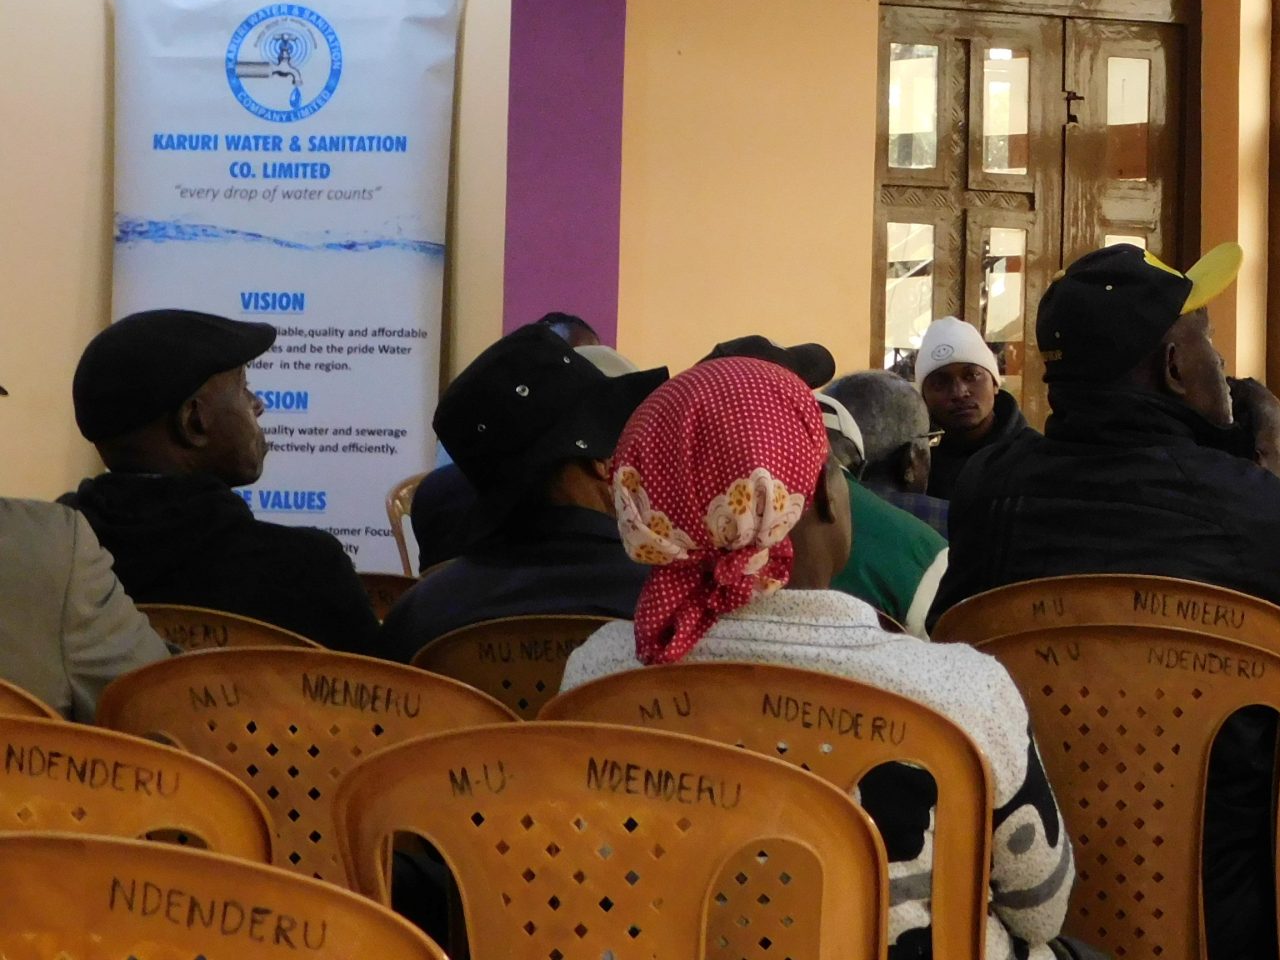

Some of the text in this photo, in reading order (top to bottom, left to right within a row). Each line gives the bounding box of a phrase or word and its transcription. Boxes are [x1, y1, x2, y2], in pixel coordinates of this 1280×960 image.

[153, 134, 407, 152] KARURI WATER & SANITATION
[229, 161, 331, 179] CO. LIMITED
[223, 185, 257, 201] drop
[261, 185, 279, 202] of
[282, 187, 323, 200] water
[240, 292, 305, 311] VISION
[275, 326, 428, 339] iable,quality and affordable
[286, 343, 307, 354] and
[309, 343, 323, 354] be
[326, 343, 344, 354] the
[346, 344, 375, 356] pride
[378, 345, 412, 355] Water
[246, 359, 351, 373] vider in the region.
[261, 425, 407, 438] uality water and sewerage
[319, 442, 339, 453] and
[341, 443, 398, 455] efficiently.
[259, 490, 327, 510] VALUES
[1148, 646, 1267, 680] NDENDERU
[761, 692, 907, 746] NDENDERU
[5, 742, 181, 799] NDENDERU
[586, 755, 743, 811] NDENDERU
[108, 876, 328, 951] NDENDERU
